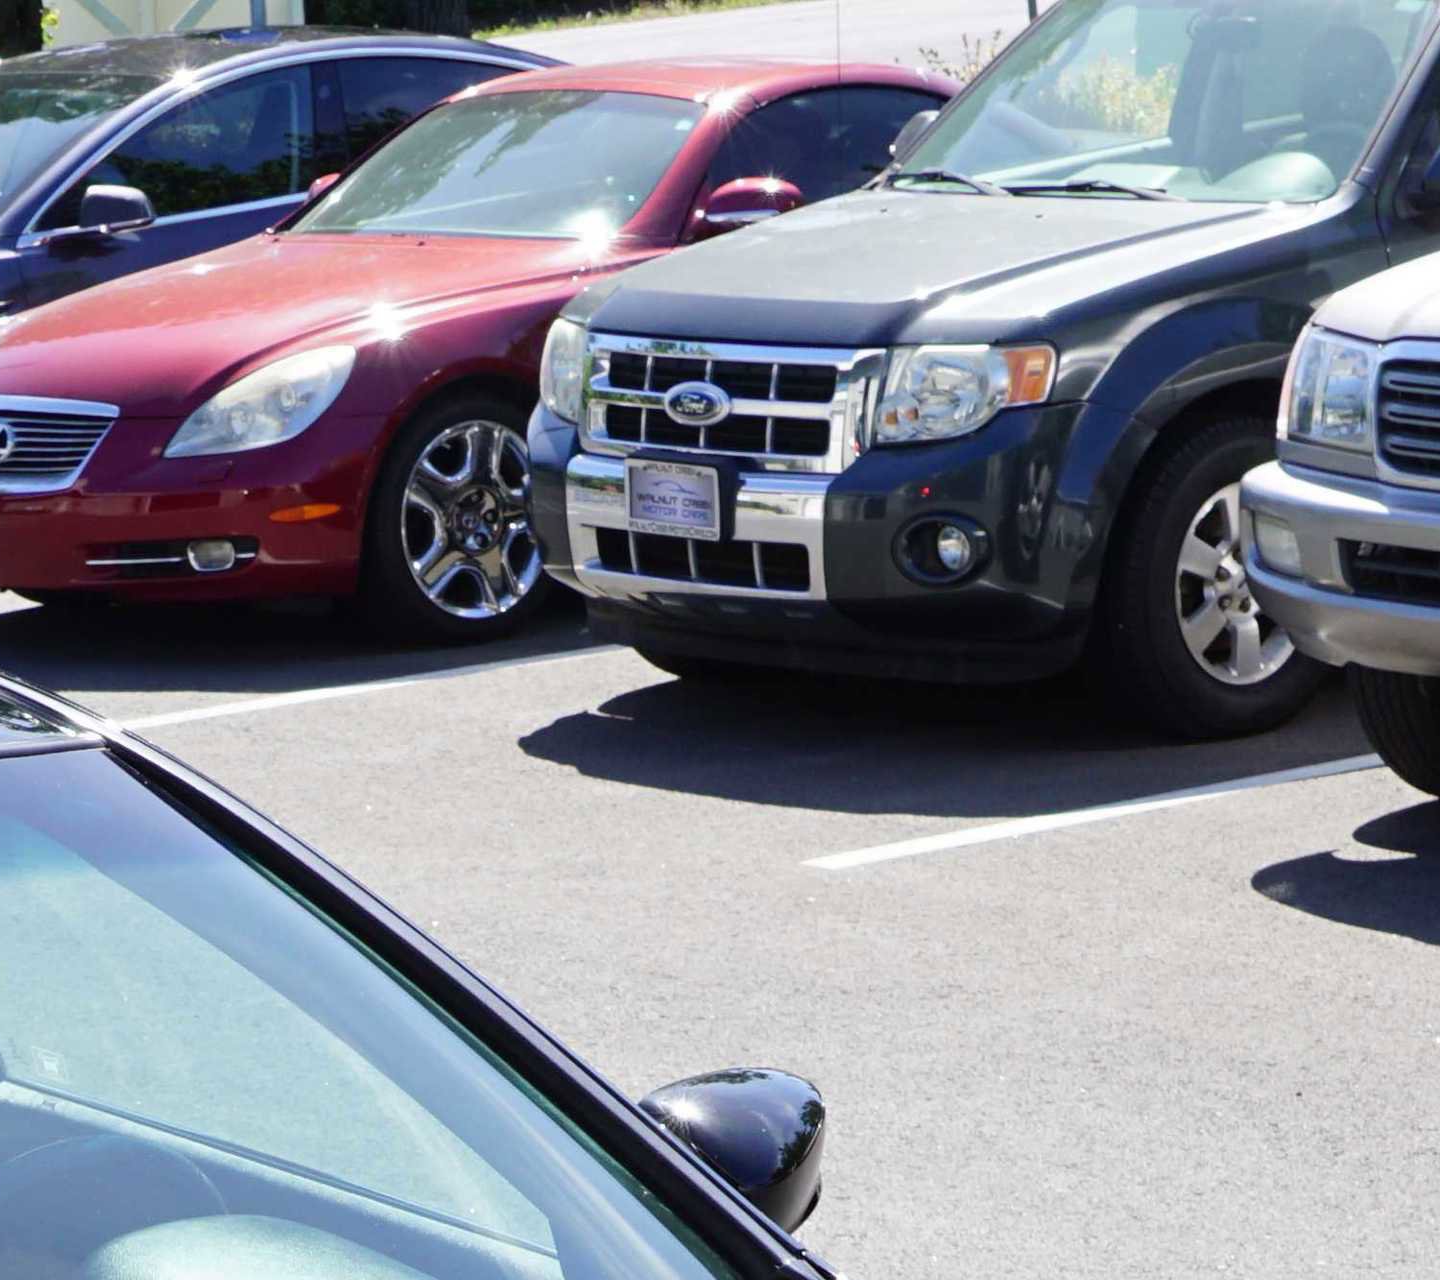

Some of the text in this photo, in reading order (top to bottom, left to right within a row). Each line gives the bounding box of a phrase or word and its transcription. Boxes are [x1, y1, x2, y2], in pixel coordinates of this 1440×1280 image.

[676, 392, 707, 414] Ford
[637, 492, 677, 505] WALNUT
[641, 504, 677, 517] MOTOR
